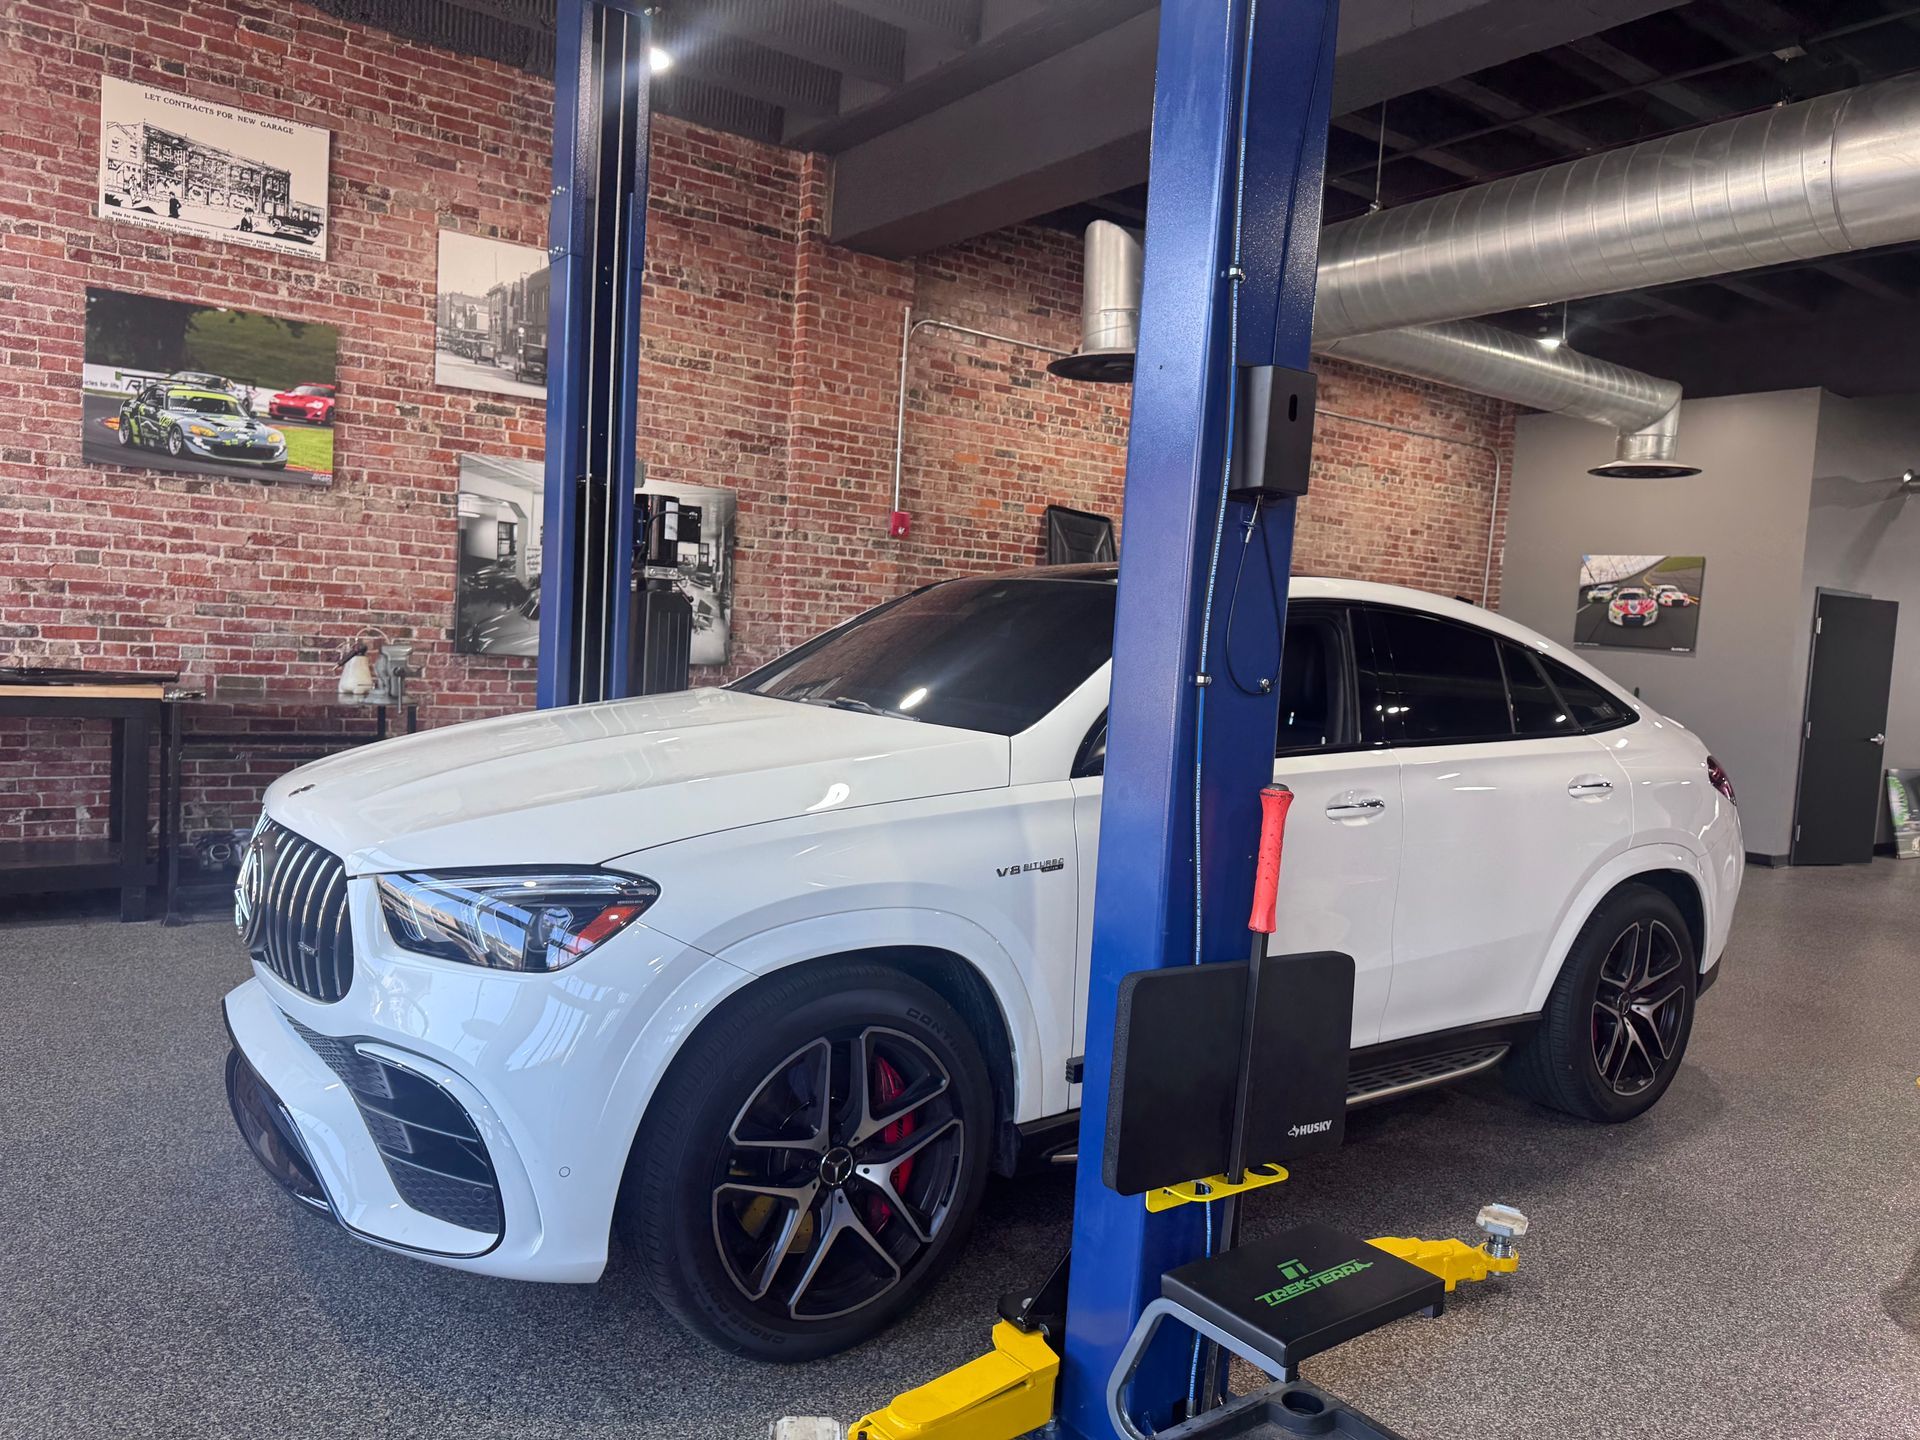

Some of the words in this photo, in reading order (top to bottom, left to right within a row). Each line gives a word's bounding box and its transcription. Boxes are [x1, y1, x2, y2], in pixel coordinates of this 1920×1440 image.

[144, 92, 162, 102] LET
[163, 96, 215, 115] CONTRACTS
[216, 110, 233, 120] FOR
[237, 115, 256, 125] NEW
[260, 120, 294, 135] GARAGE
[996, 865, 1021, 878] V8
[1023, 857, 1064, 871] BITURBO
[1299, 1119, 1333, 1136] HUSKY
